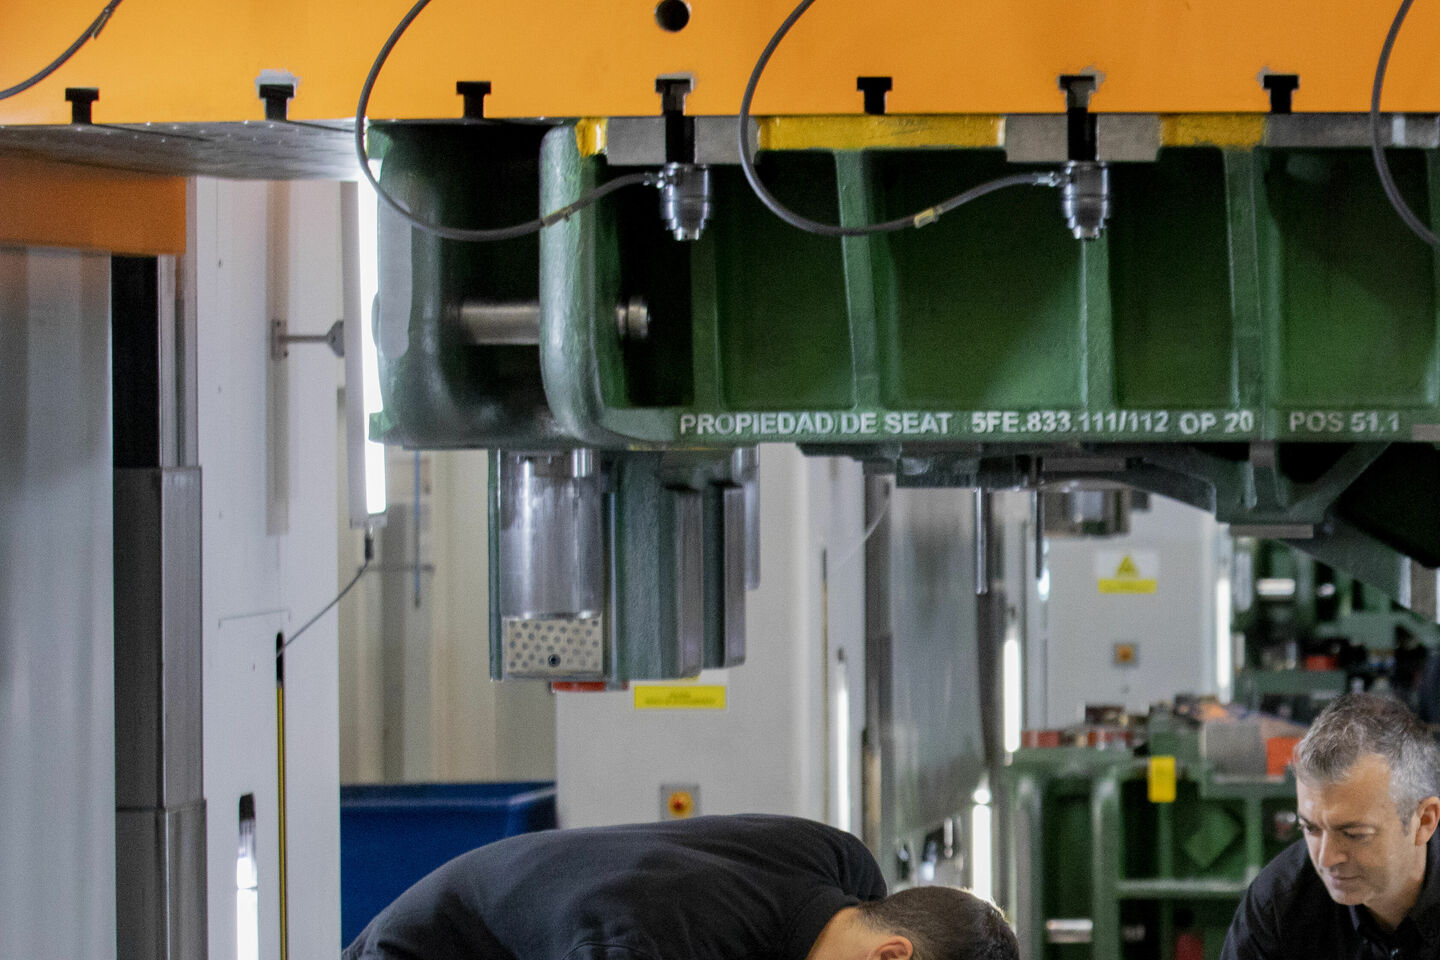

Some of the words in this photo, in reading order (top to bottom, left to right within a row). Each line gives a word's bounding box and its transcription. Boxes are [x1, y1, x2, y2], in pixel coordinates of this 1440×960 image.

[679, 412, 836, 436] PROPIEDAD
[840, 411, 878, 436] DE
[883, 411, 954, 436] SEAT
[1179, 412, 1216, 436] OP
[1223, 410, 1255, 434] 20
[1289, 411, 1346, 434] POS
